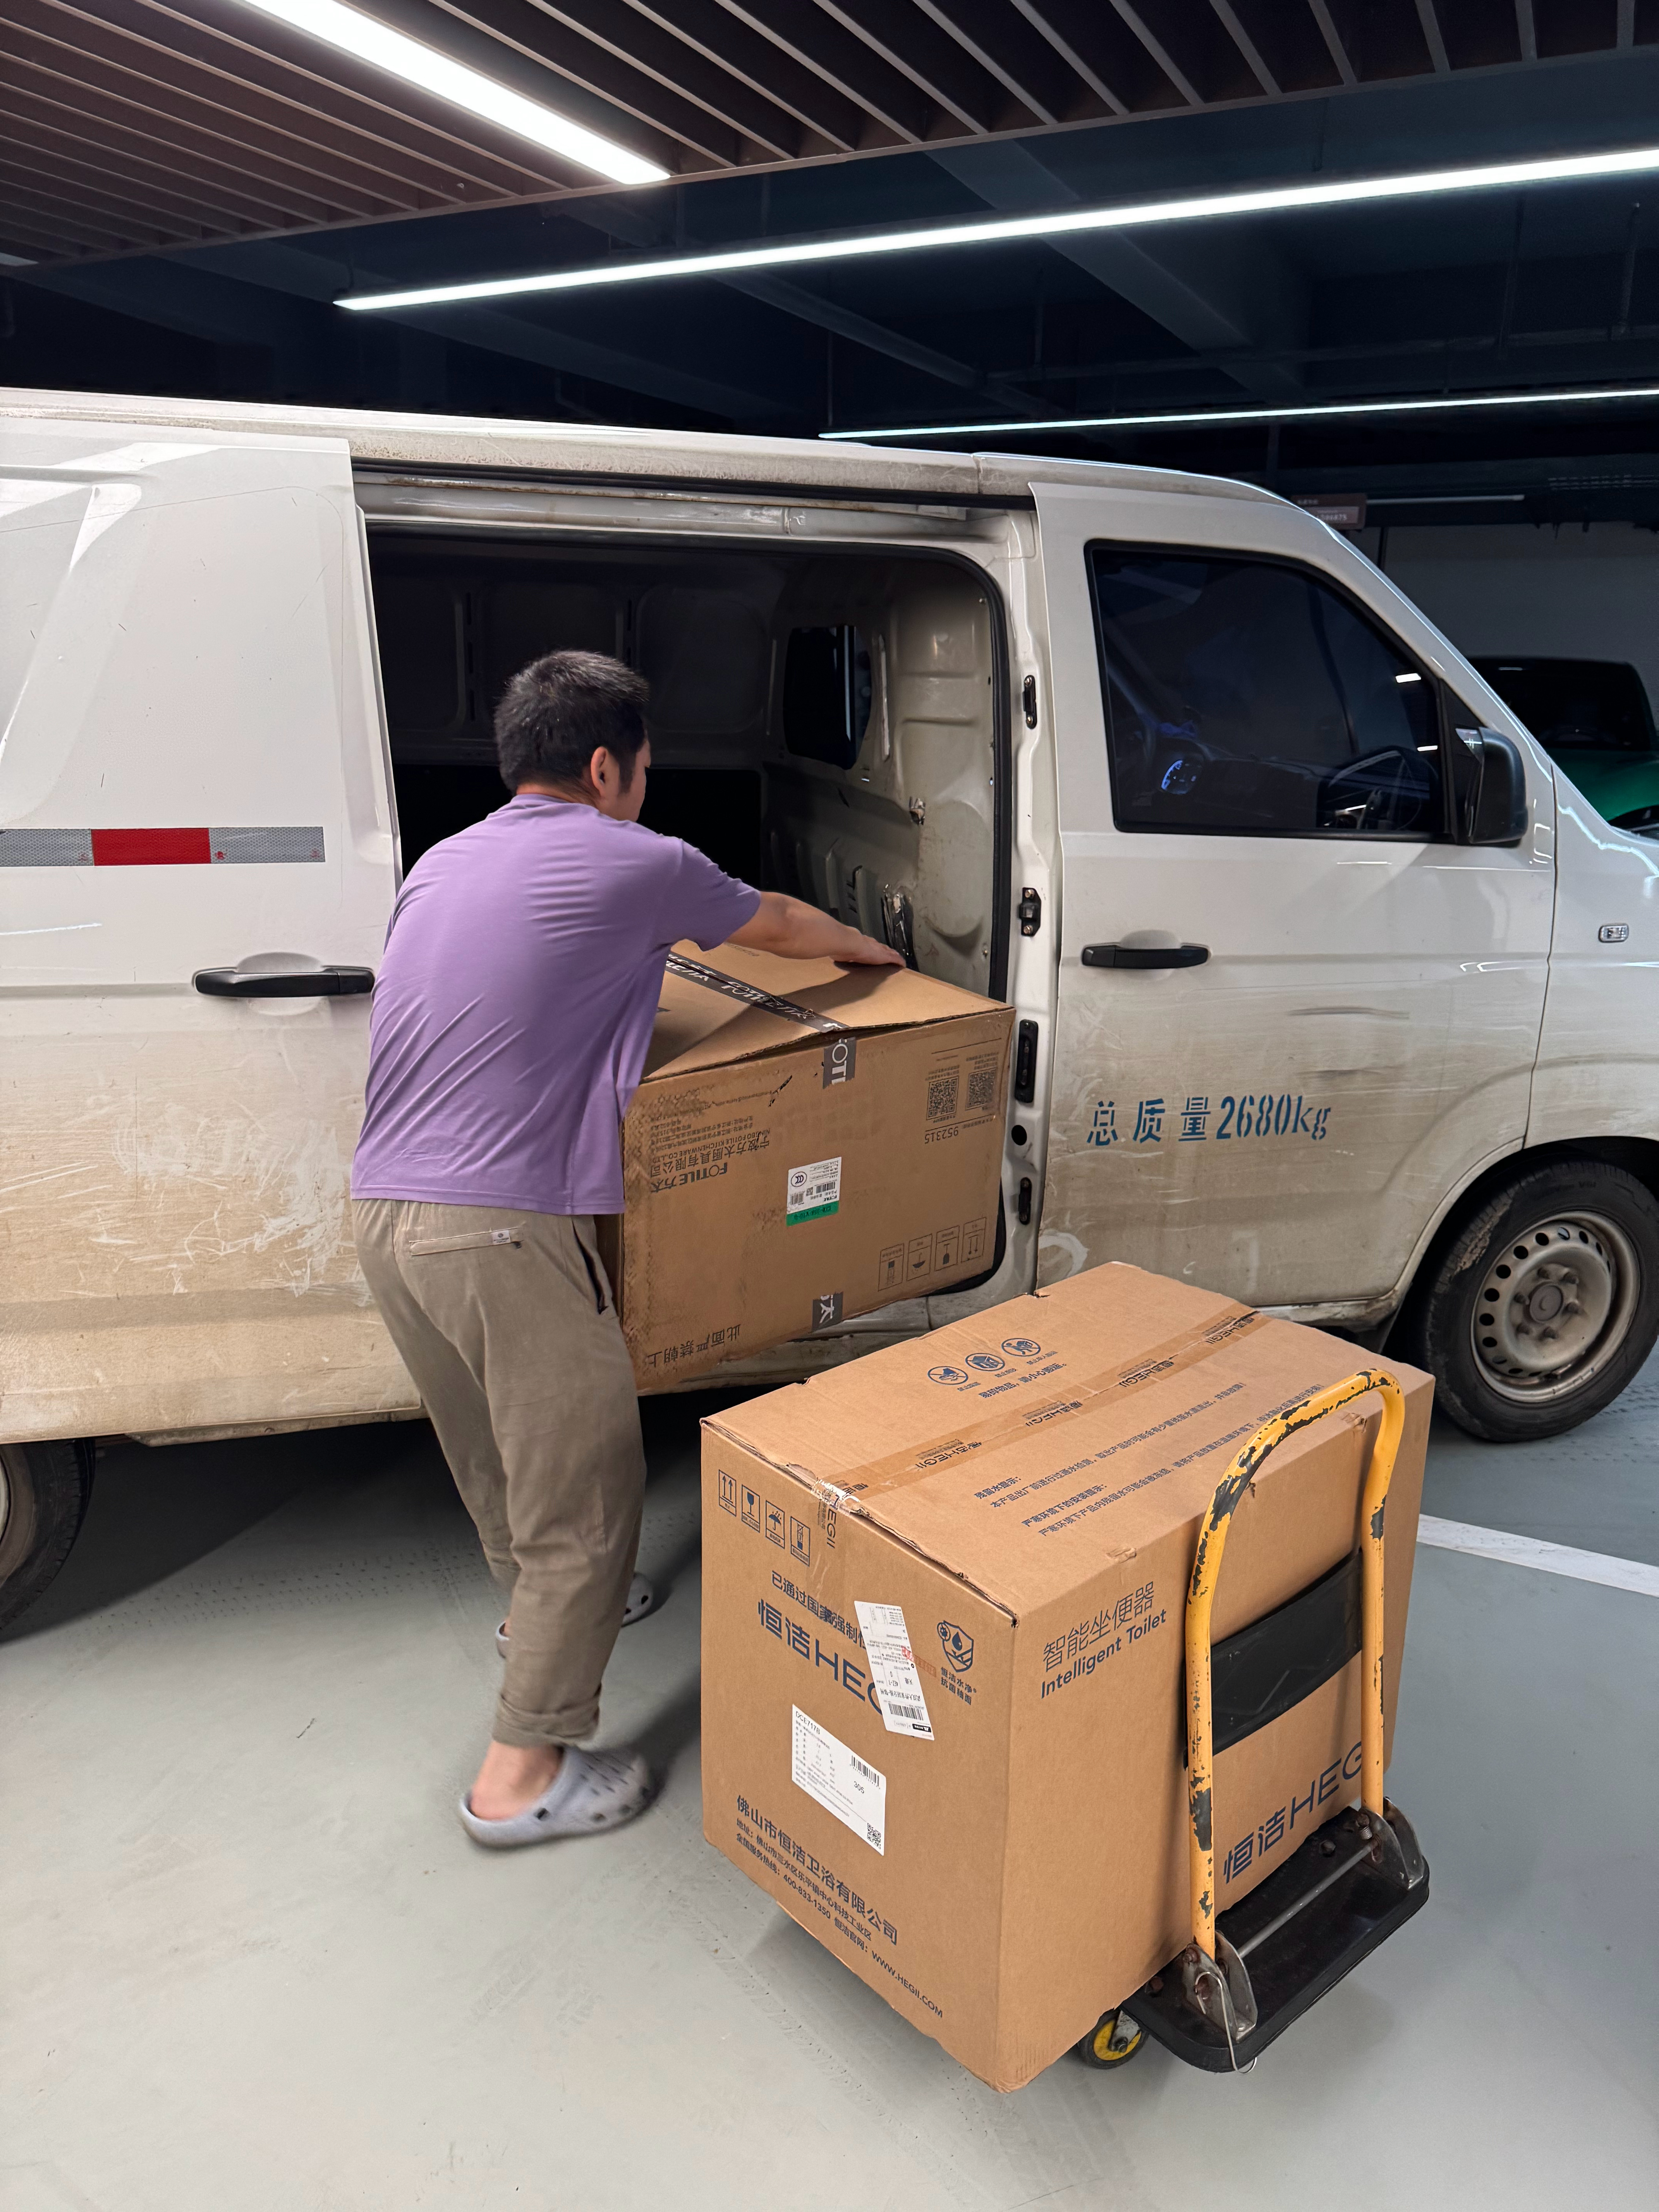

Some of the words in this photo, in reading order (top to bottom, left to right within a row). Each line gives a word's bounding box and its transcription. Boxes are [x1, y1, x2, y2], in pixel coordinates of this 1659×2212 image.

[679, 1138, 724, 1157] KITCHENWARE
[725, 1135, 746, 1145] FOTILE
[925, 1126, 958, 1144] 952315
[650, 1135, 770, 1178] 宁波方太厨具有限公司
[650, 1175, 676, 1193] 方太
[679, 1163, 728, 1186] FOTILE
[647, 1324, 741, 1367] 此面严禁朝上
[1043, 1581, 1155, 1672] 智能坐便器
[1041, 1635, 1121, 1698] Intelligent
[1127, 1608, 1167, 1644] Toilet
[941, 1677, 972, 1705] 抗菌釉面
[854, 1780, 864, 1795] 305
[737, 1795, 897, 1946] 佛山市恒洁卫浴有限公司
